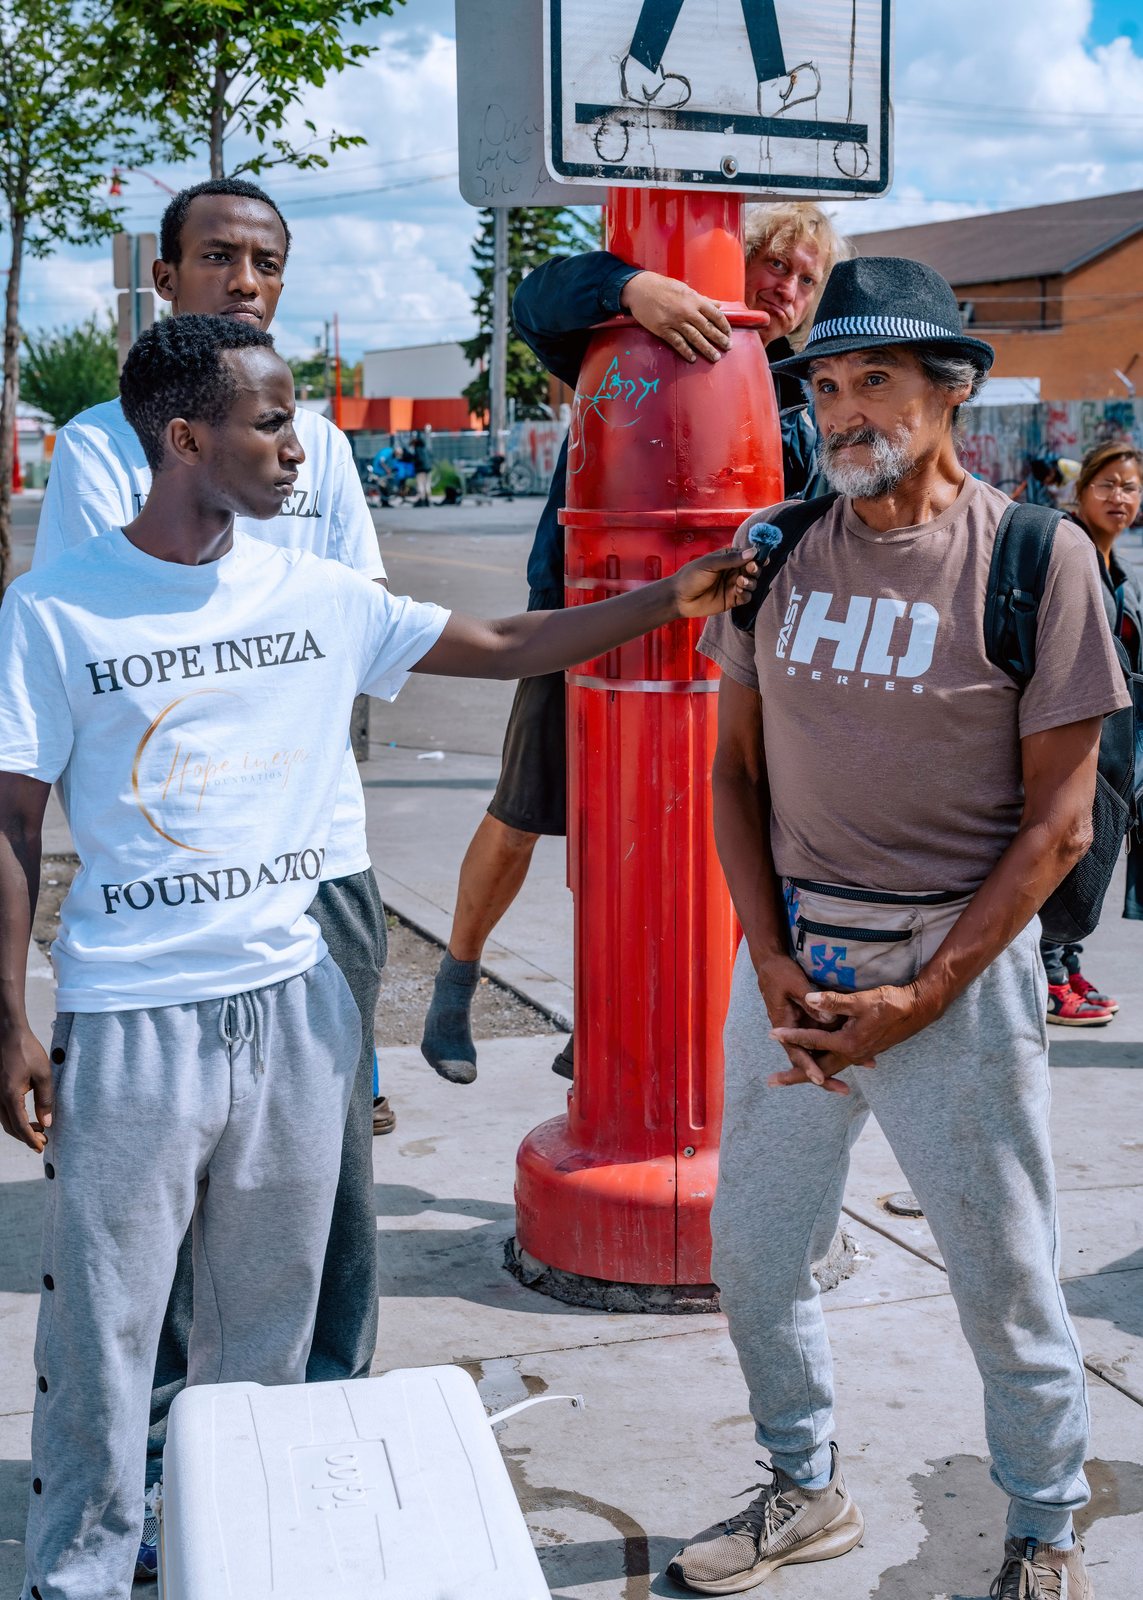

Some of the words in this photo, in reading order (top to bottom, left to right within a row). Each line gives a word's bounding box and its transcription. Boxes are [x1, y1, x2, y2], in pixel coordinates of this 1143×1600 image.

[775, 585, 803, 659] FAST
[789, 590, 940, 678] HD
[85, 644, 205, 695] HOPE
[212, 629, 326, 674] INEZA
[786, 666, 924, 694] SERIES
[101, 847, 325, 915] FOUNDATIO
[312, 1453, 378, 1512] igloo
